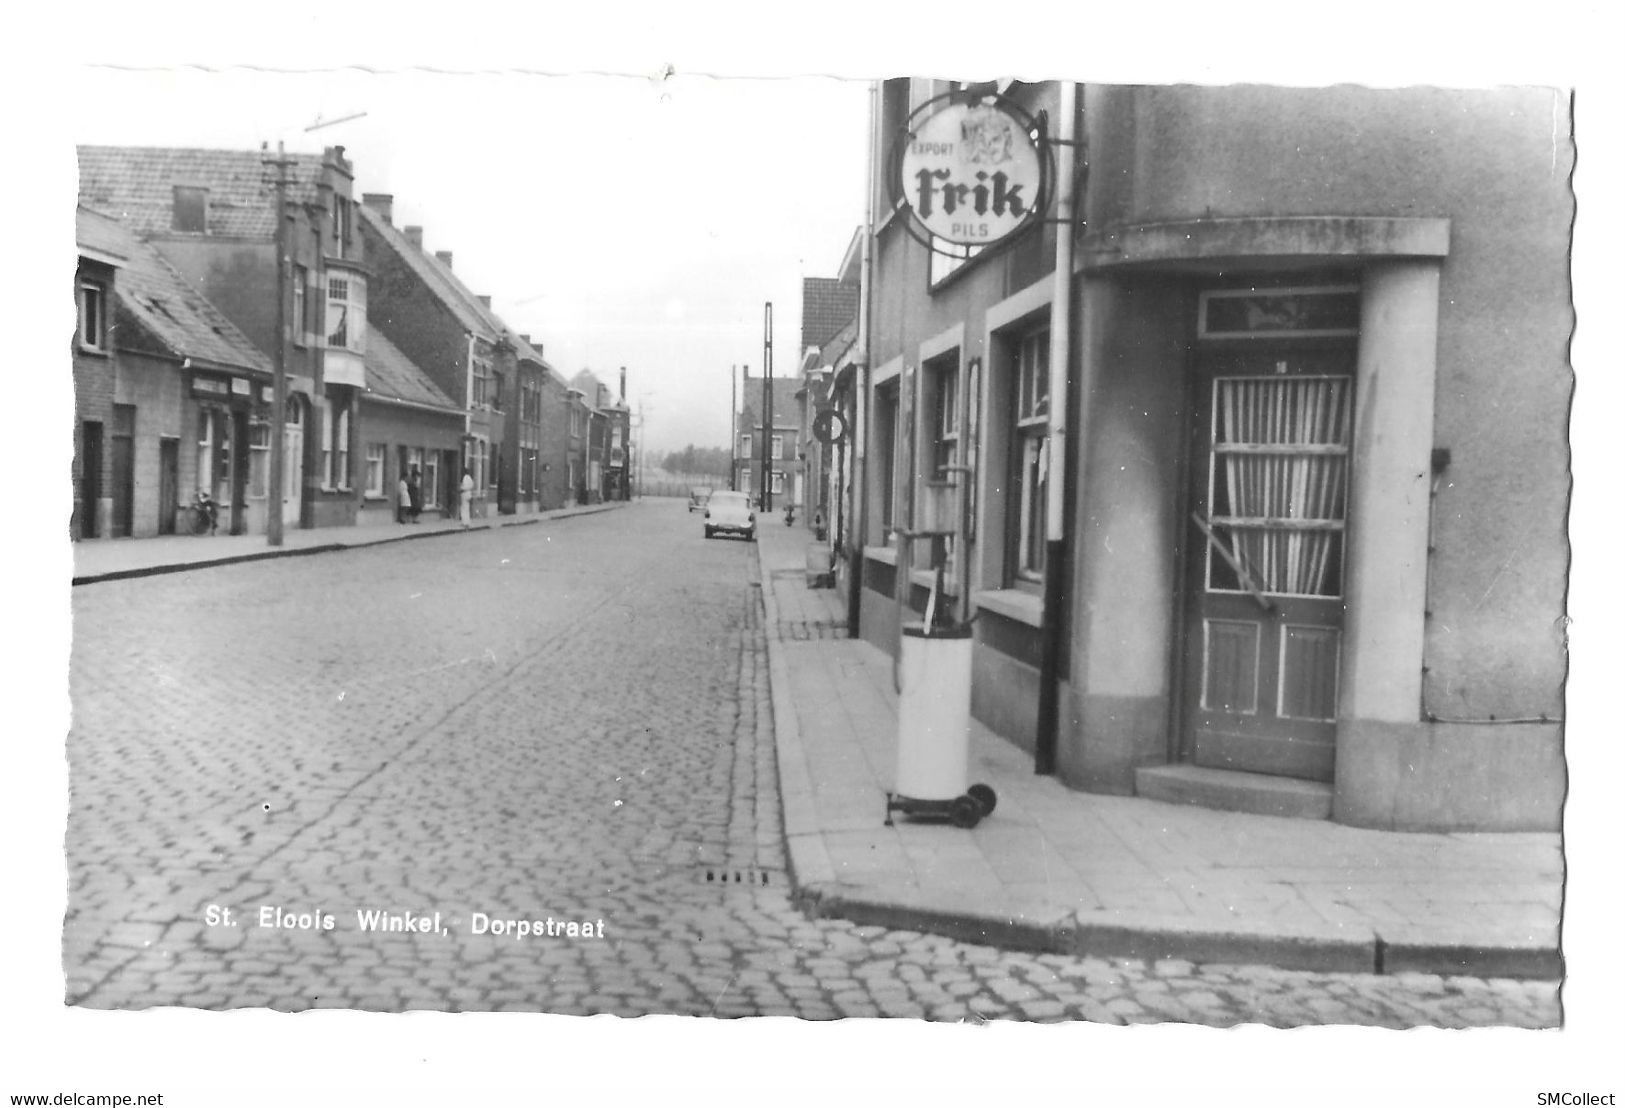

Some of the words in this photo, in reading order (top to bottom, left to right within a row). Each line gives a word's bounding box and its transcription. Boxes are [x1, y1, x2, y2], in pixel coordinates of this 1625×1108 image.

[911, 143, 954, 155] EXPORT
[915, 167, 1026, 219] Frik
[951, 223, 988, 237] PILS
